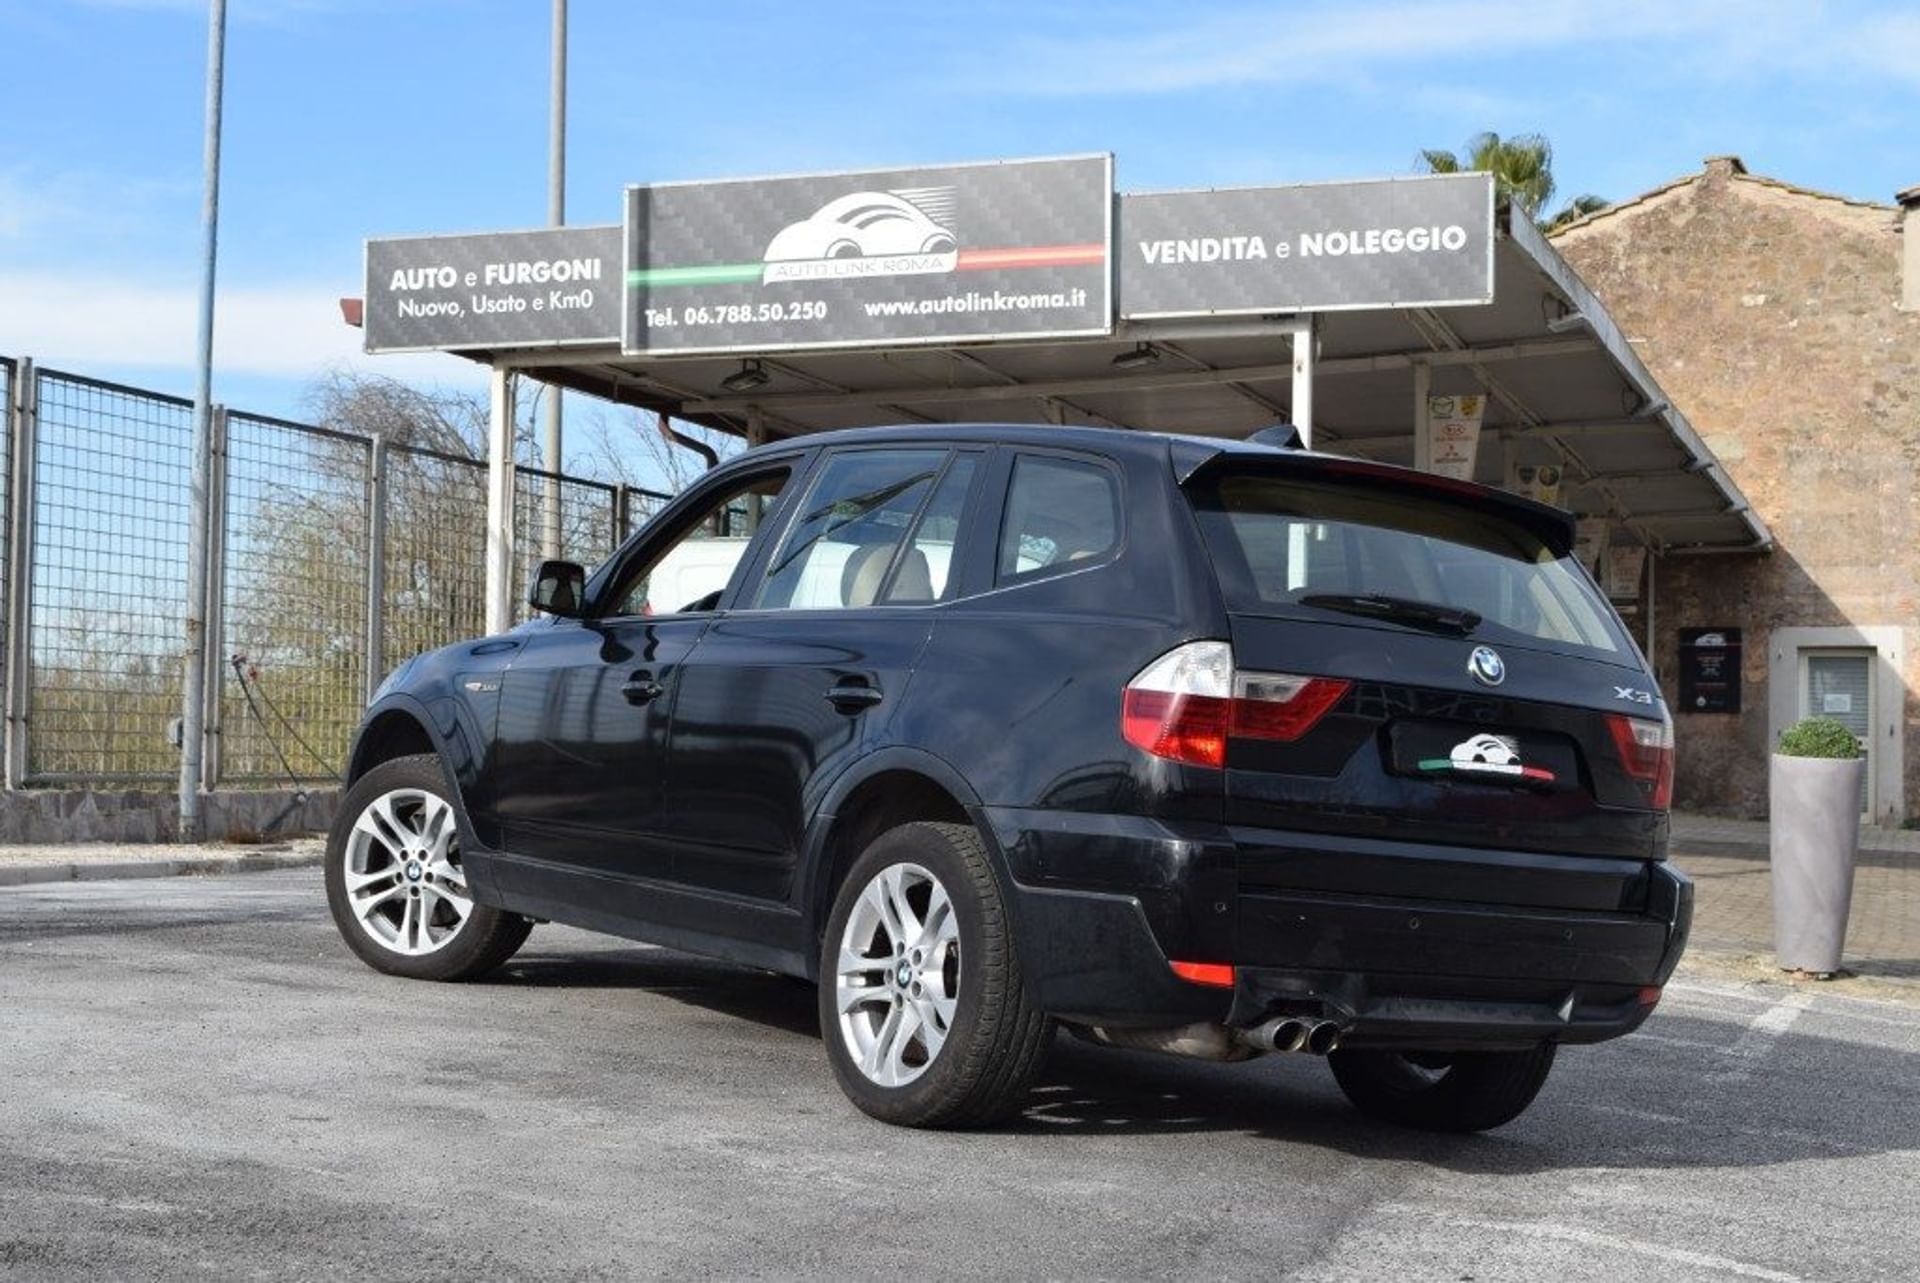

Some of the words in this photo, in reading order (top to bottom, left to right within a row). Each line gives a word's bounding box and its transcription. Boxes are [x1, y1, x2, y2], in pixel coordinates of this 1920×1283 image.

[1139, 236, 1267, 264] VENDITA
[1275, 241, 1291, 258] e
[1300, 225, 1467, 257] NOLEGGIO
[389, 266, 457, 291] AUTO
[464, 271, 478, 287] e
[485, 258, 601, 286] FURGONI
[775, 264, 828, 278] AUTO
[834, 260, 876, 275] LINK
[883, 256, 944, 272] ROMA
[398, 299, 466, 318] Nuovo,
[472, 294, 526, 314] Usato
[532, 297, 544, 310] e
[550, 289, 593, 309] Km0
[644, 307, 679, 327] Tel.
[684, 301, 828, 325] 06.788.50.250
[865, 288, 1087, 316] www.autolinkroma.it
[1613, 686, 1652, 704] X3
